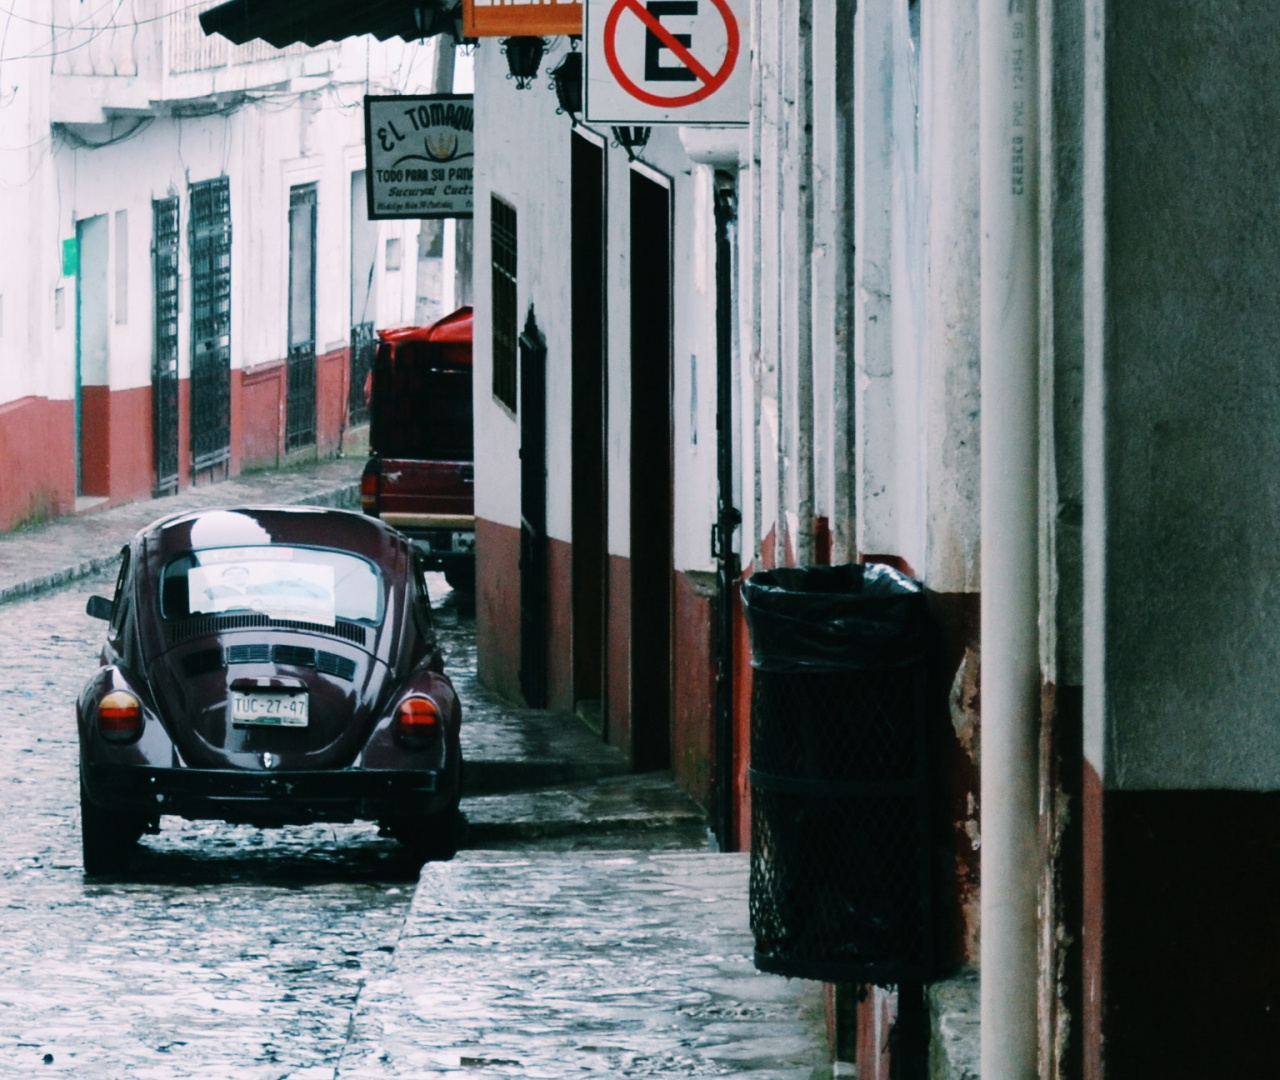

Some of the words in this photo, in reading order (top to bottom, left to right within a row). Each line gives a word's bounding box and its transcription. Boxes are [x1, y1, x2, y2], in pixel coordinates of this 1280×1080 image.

[645, 1, 698, 81] E
[1011, 100, 1024, 127] PVC
[375, 169, 403, 183] TODO
[405, 169, 428, 182] PARA
[431, 168, 445, 182] SU
[1011, 136, 1024, 196] CRESCO
[388, 185, 438, 197] Sucursal
[235, 698, 305, 715] TUC-27-47
